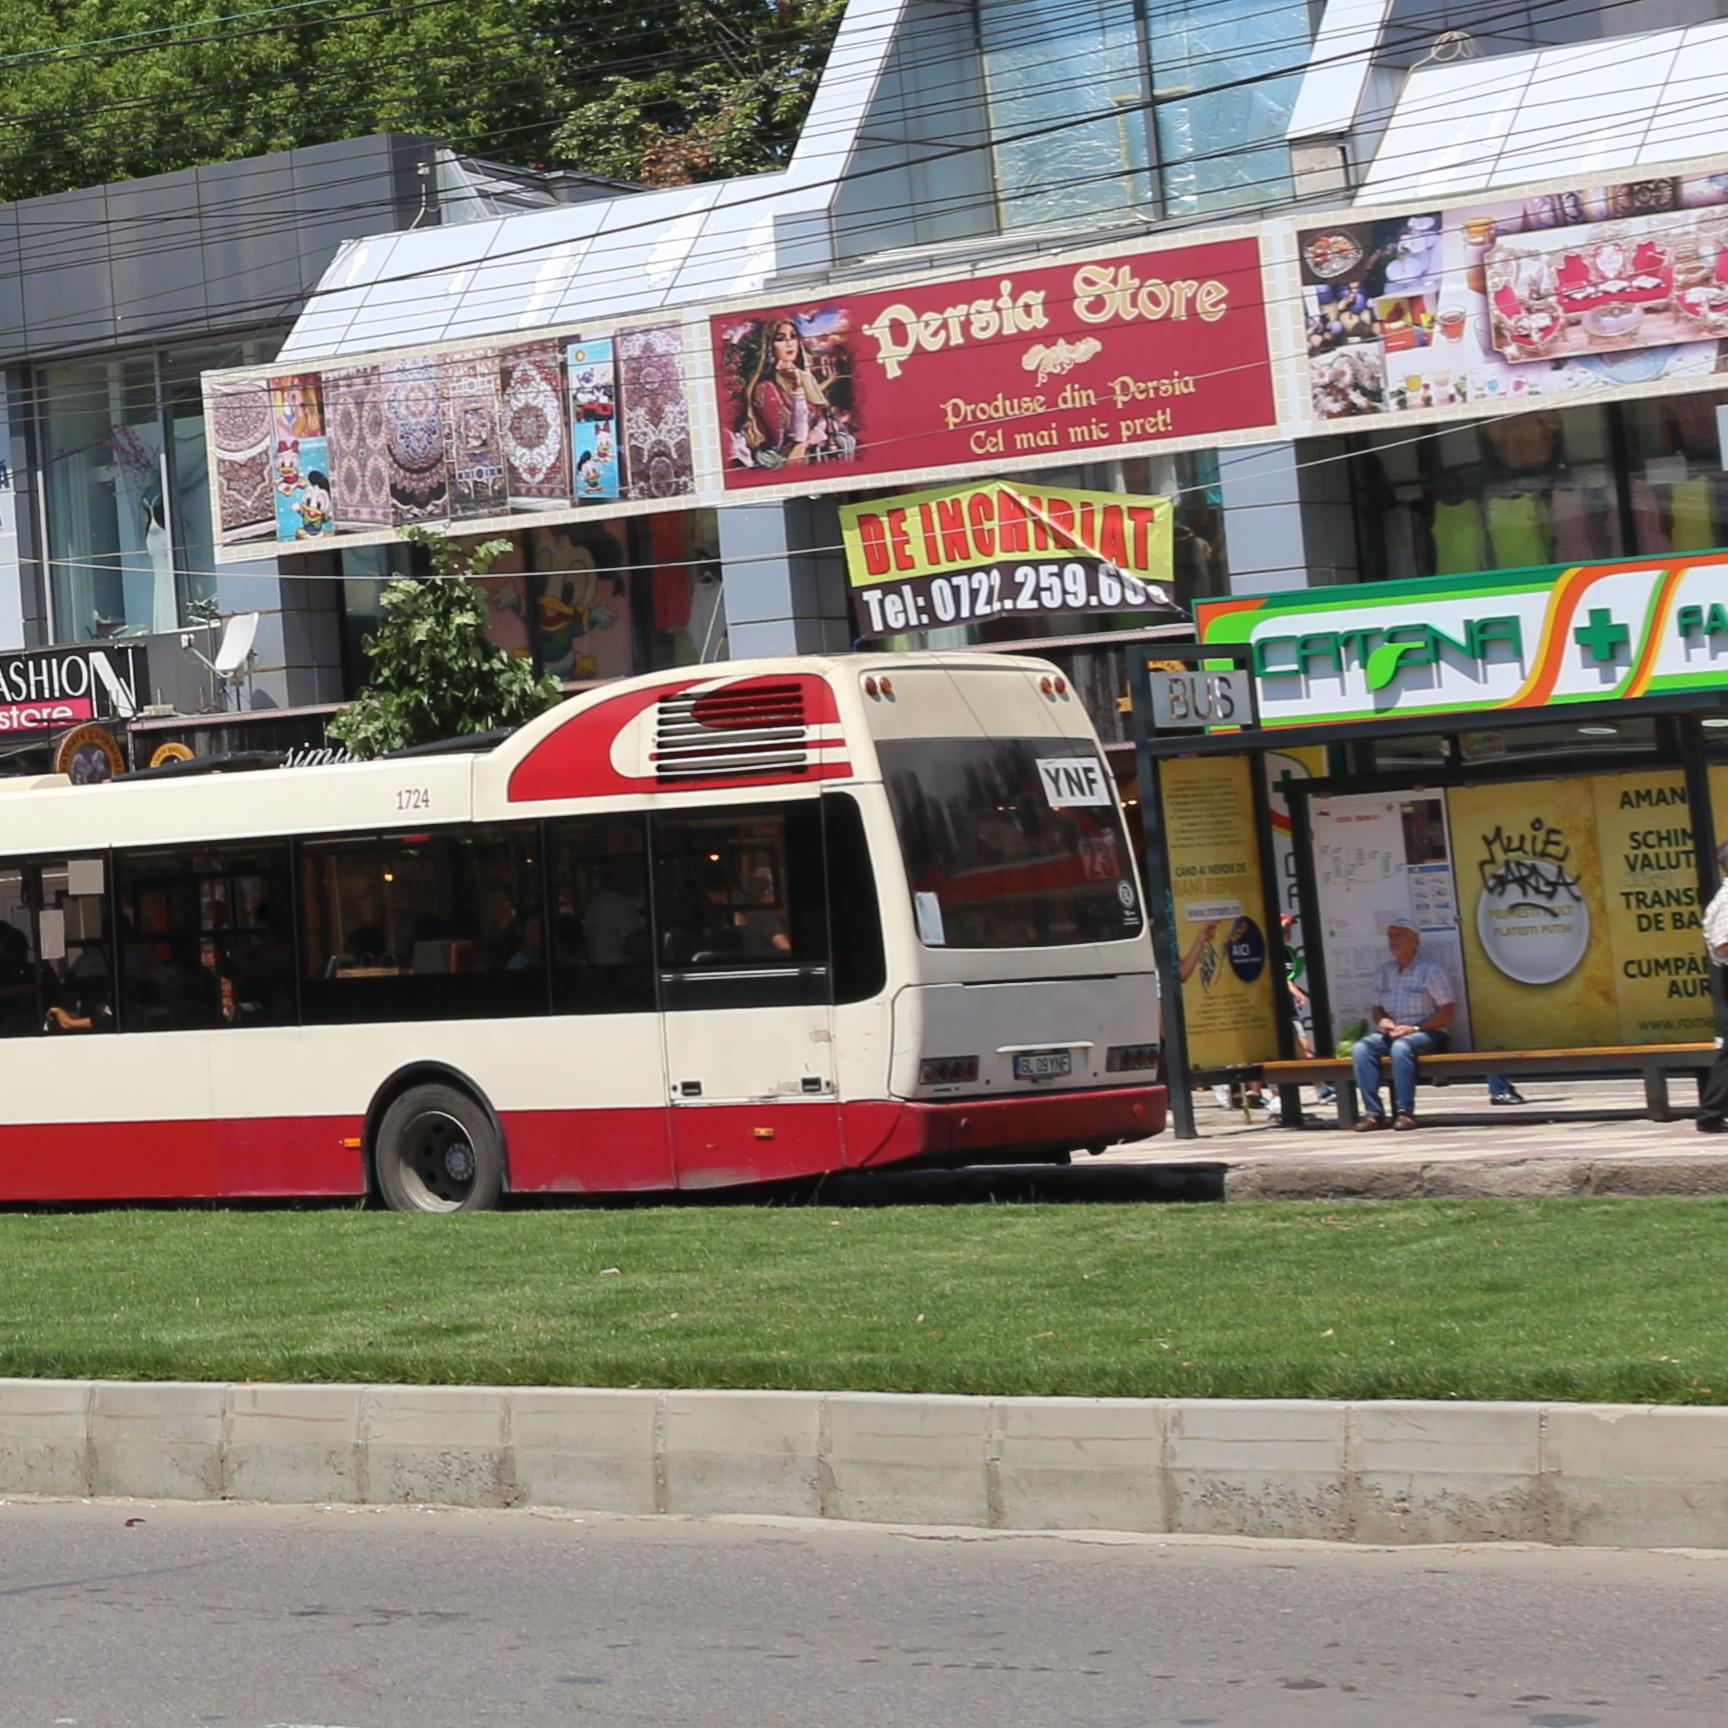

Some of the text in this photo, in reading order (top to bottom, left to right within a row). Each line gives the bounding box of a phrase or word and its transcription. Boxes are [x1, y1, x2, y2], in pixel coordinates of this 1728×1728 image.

[862, 265, 1229, 380] Persia Store
[941, 369, 1197, 430] Produse din Persia
[970, 408, 1173, 455] Cel mai mic pret!
[856, 489, 1155, 576] DE INCHIRIAT
[861, 585, 931, 633] Tel:
[1252, 614, 1522, 679] CATENA
[1167, 675, 1235, 721] BUS
[396, 788, 430, 811] 1724
[1043, 766, 1098, 798] YNF
[1637, 914, 1665, 933] DE
